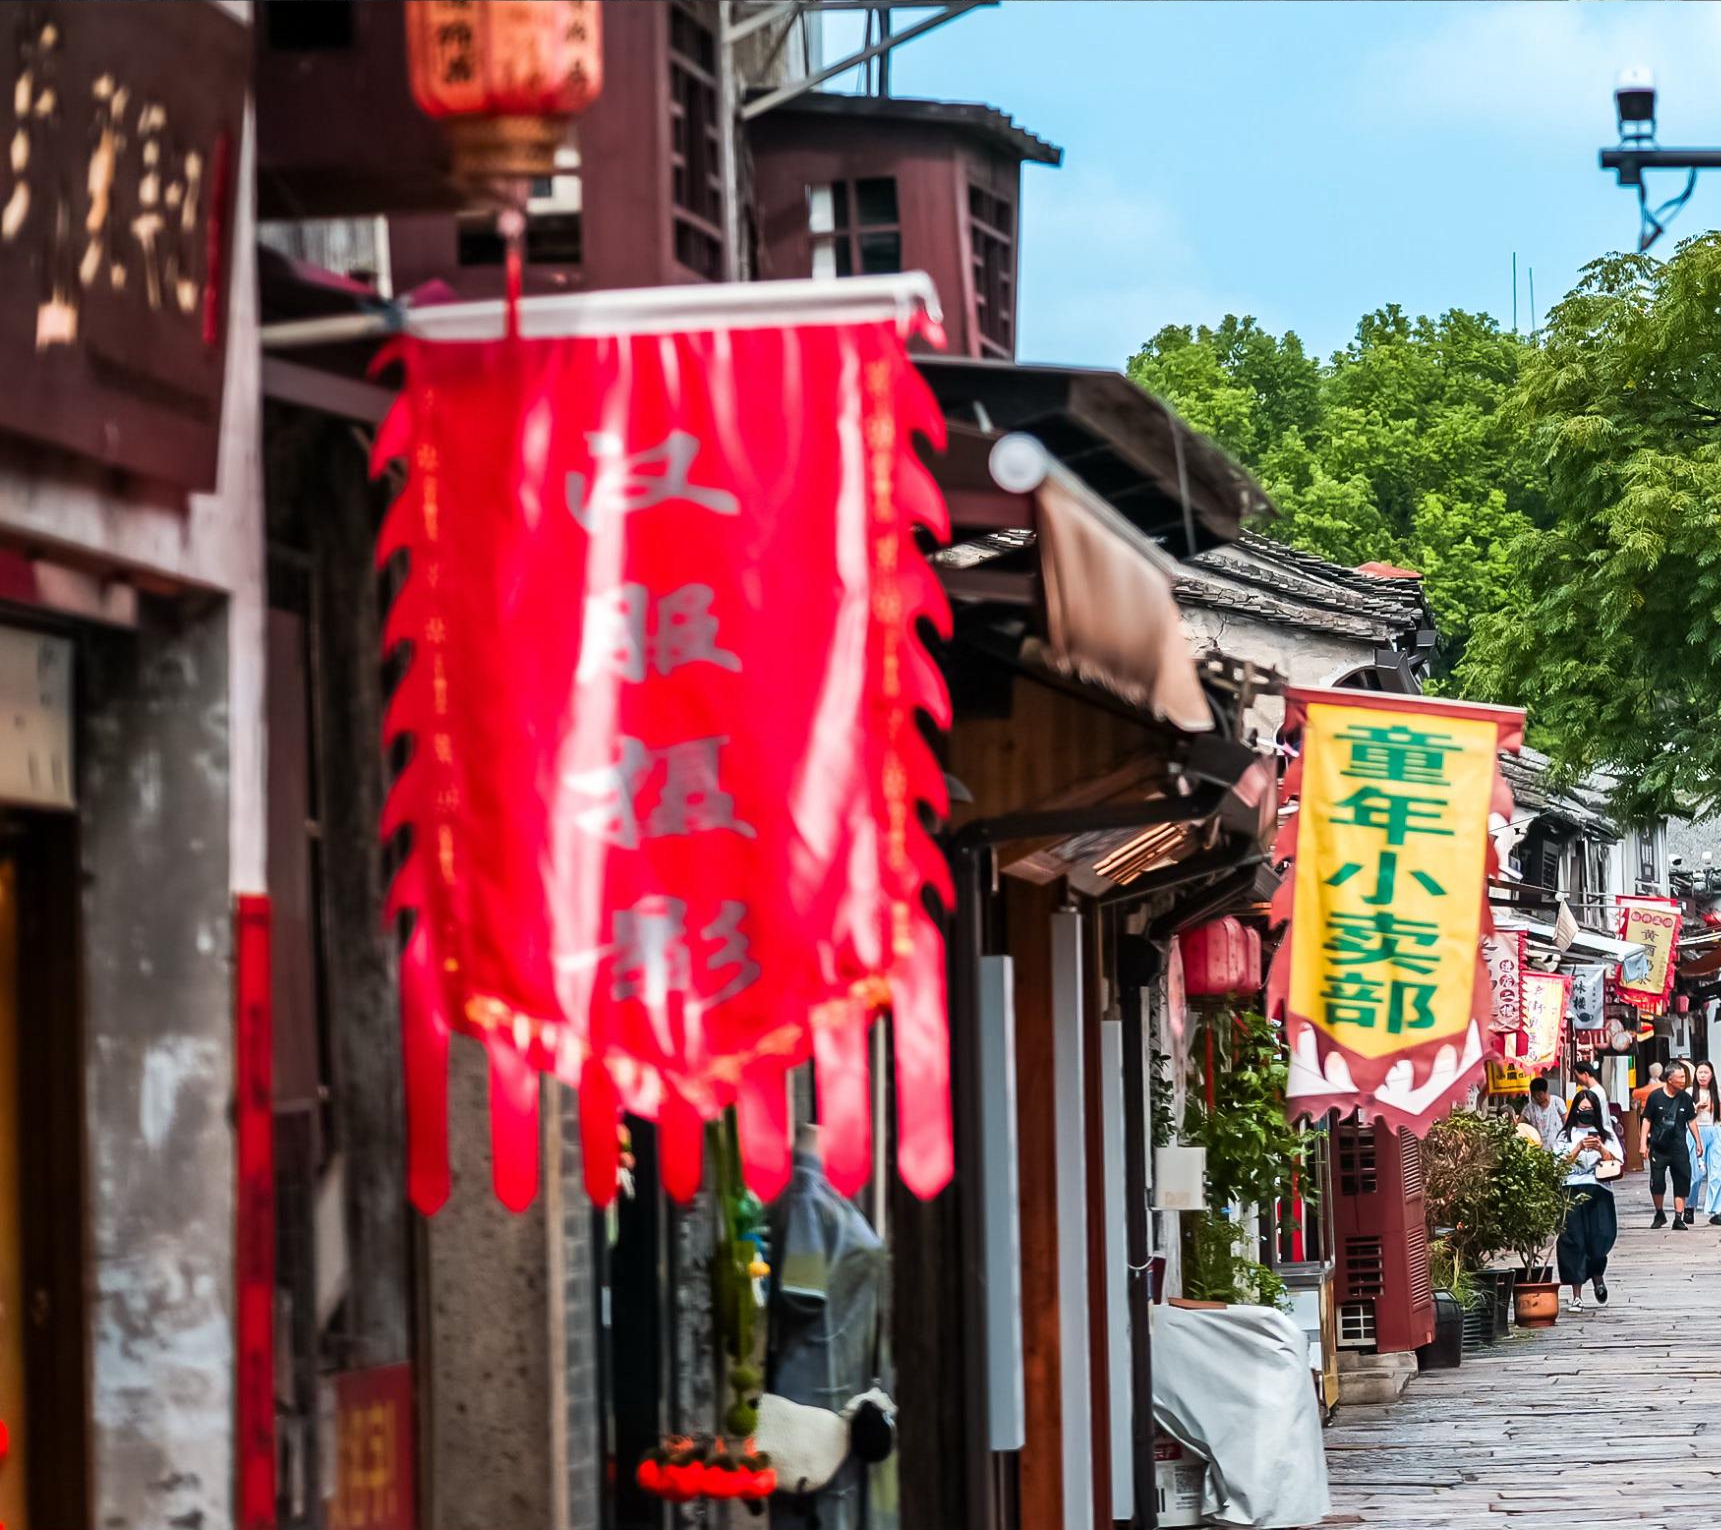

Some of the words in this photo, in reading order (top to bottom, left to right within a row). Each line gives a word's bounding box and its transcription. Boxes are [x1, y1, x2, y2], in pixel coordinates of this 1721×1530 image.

[1321, 724, 1463, 1035] 童年小卖部
